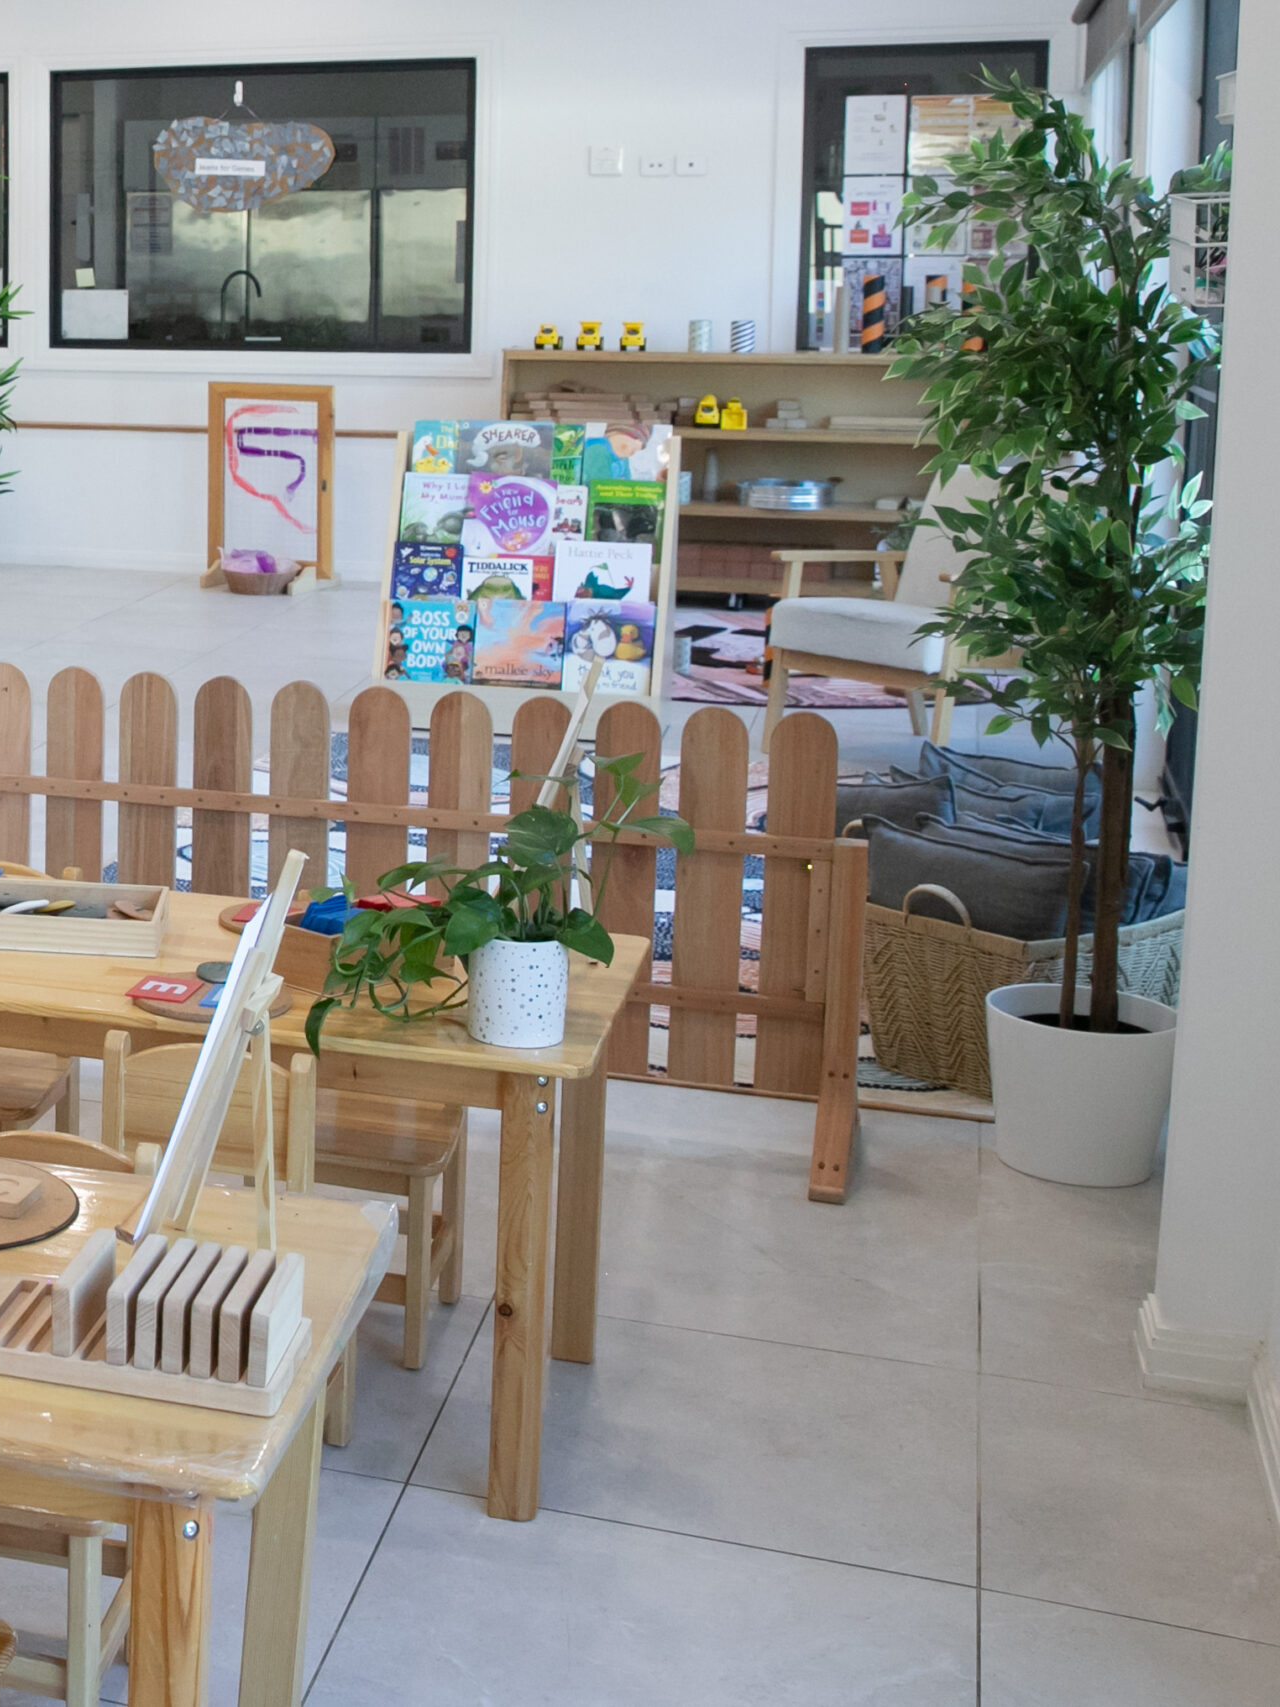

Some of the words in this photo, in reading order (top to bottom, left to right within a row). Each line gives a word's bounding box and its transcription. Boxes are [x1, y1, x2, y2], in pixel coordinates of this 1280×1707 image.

[481, 428, 537, 444] SHEARER
[479, 490, 534, 521] Friend
[491, 514, 546, 538] Mouse
[568, 546, 602, 558] Hattie
[608, 548, 633, 560] Peck
[468, 561, 528, 573] TIDDALICK
[411, 610, 450, 626] BOSS
[403, 627, 417, 639] OF
[420, 627, 458, 641] YOUR
[411, 640, 446, 654] OWN
[407, 654, 446, 668] BODY
[484, 663, 528, 676] mallee
[533, 665, 554, 678] sky
[617, 669, 635, 684] you
